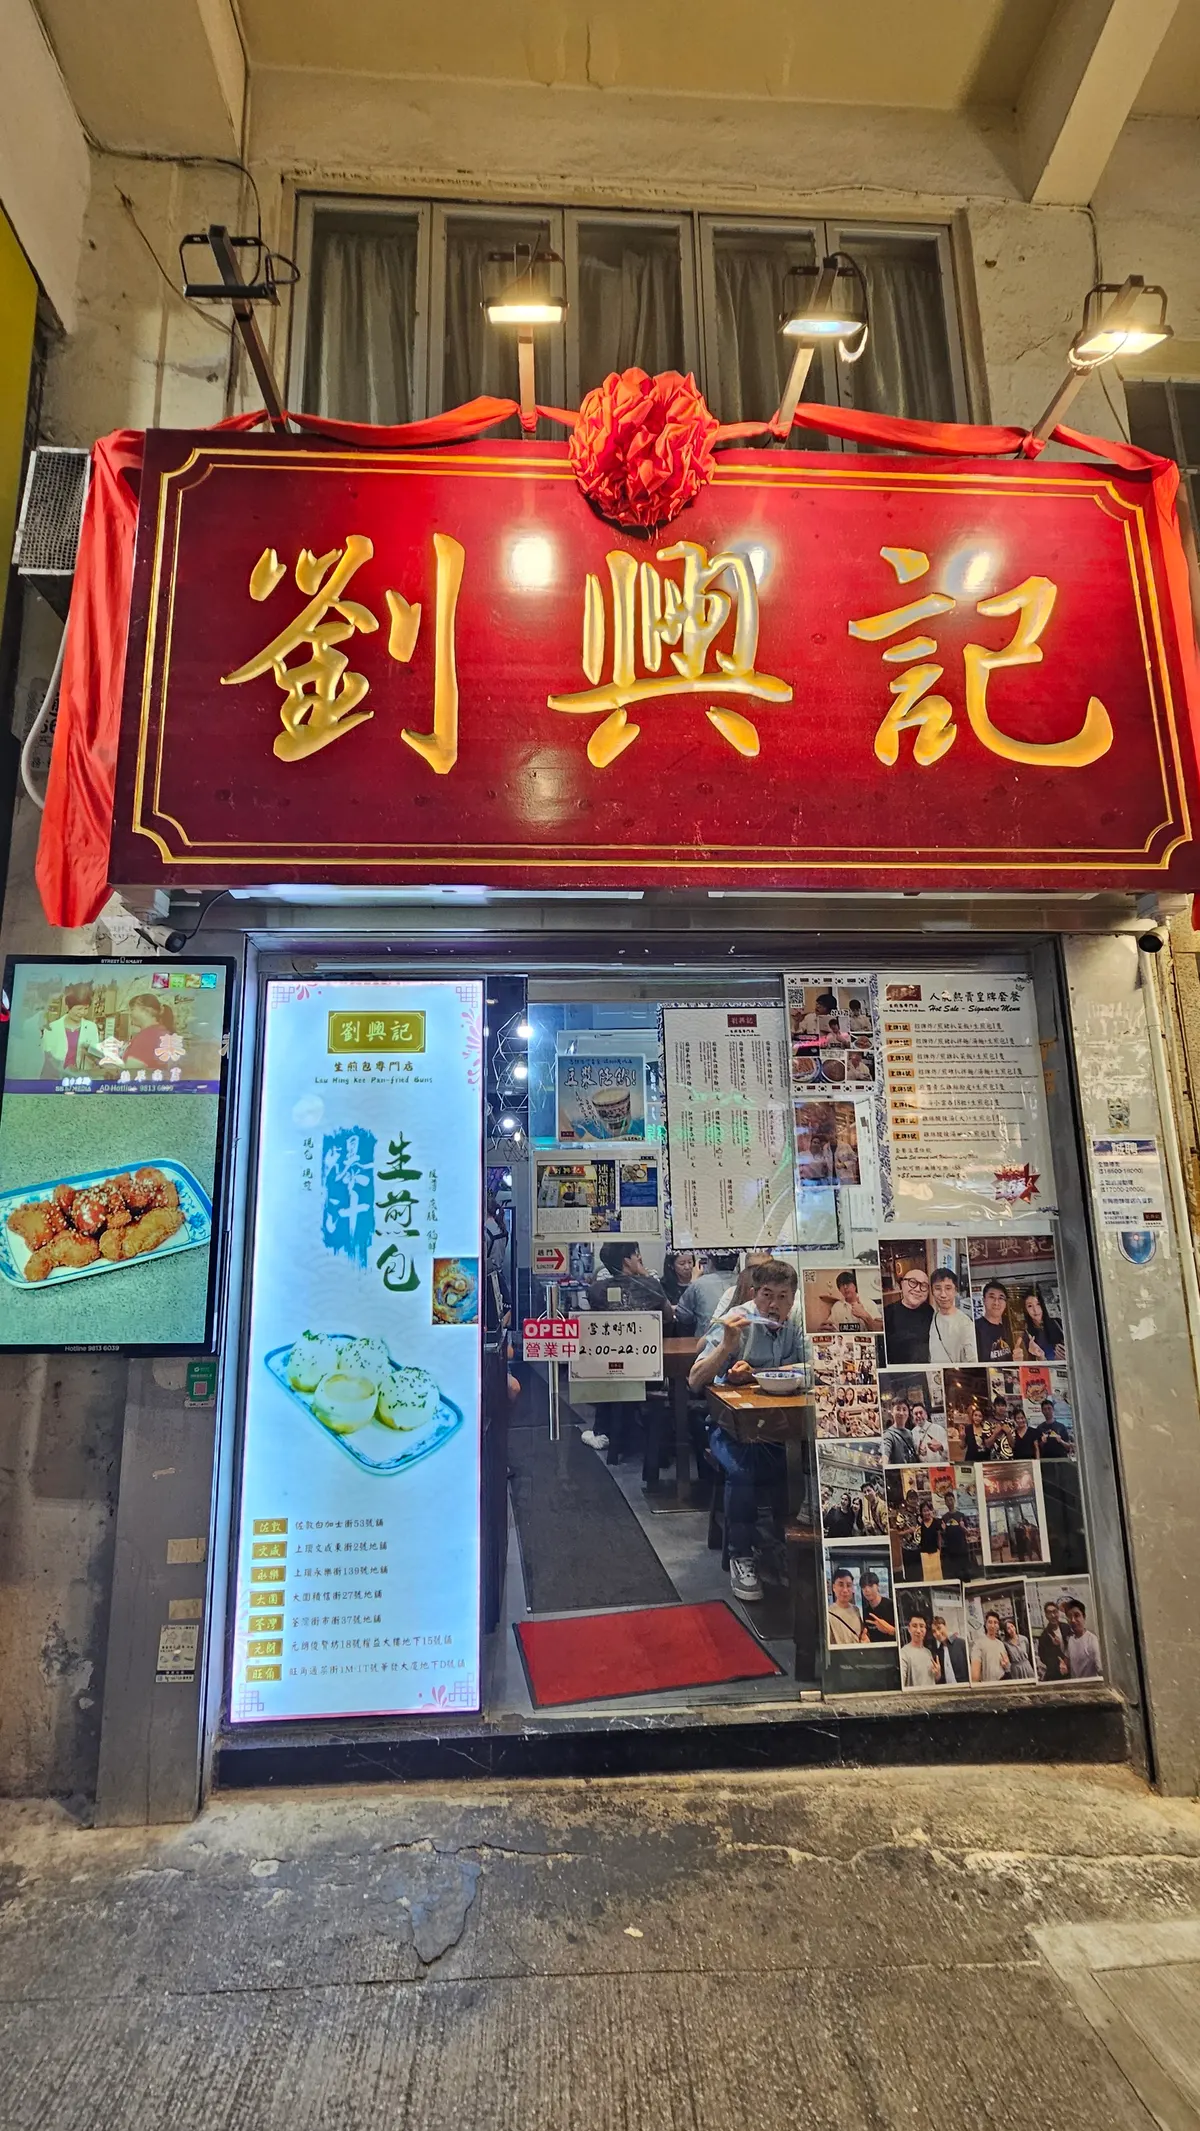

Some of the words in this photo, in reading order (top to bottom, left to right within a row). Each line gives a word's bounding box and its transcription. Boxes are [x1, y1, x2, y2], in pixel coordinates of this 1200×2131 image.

[220, 532, 1114, 775] 劉興記
[928, 1004, 942, 1012] Hot
[968, 1004, 999, 1013] Signature
[1000, 1004, 1021, 1012] Menu
[340, 1020, 414, 1044] 劉興記
[376, 1131, 423, 1292] 生煎包
[525, 1323, 578, 1337] OPEN
[526, 1341, 577, 1359] 營業中
[579, 1344, 658, 1356] 2:00-22:00
